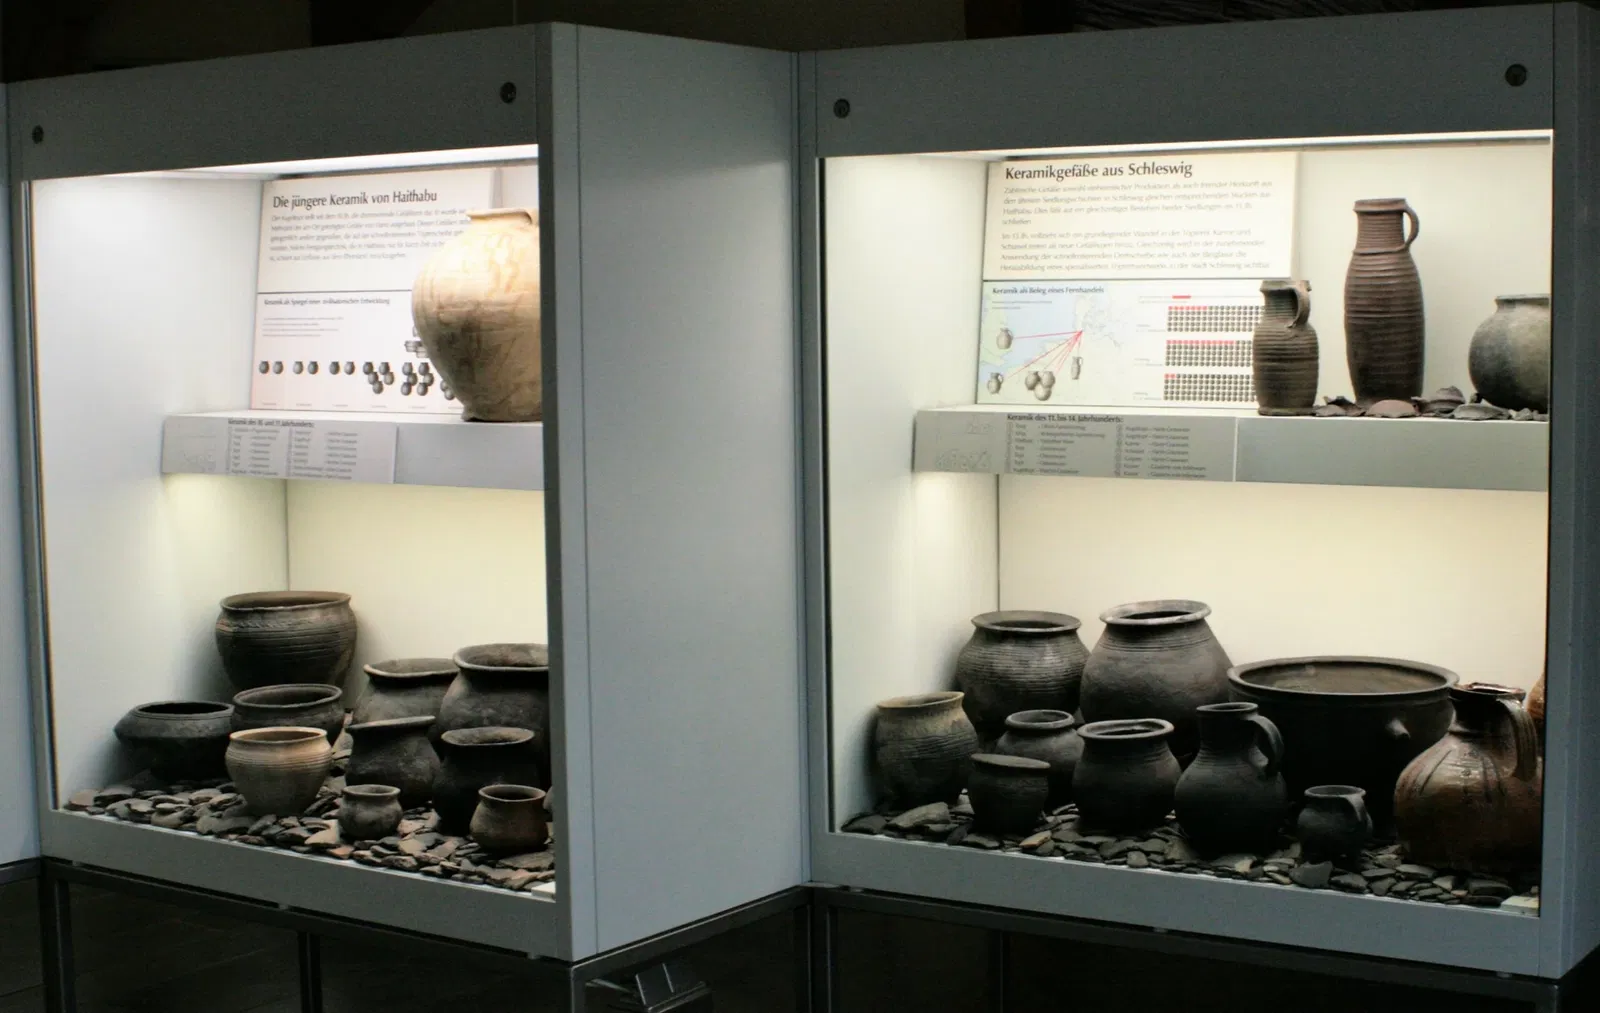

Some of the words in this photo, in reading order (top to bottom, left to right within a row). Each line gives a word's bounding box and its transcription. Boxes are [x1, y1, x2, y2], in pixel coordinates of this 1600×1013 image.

[1006, 164, 1099, 182] Keramikgefäße
[1102, 166, 1124, 176] aus
[1128, 161, 1193, 178] Schleswig
[272, 196, 288, 208] Die
[291, 195, 327, 211] jüngere
[329, 192, 369, 206] Keramik
[371, 194, 390, 204] von
[393, 189, 437, 203] Haithabu
